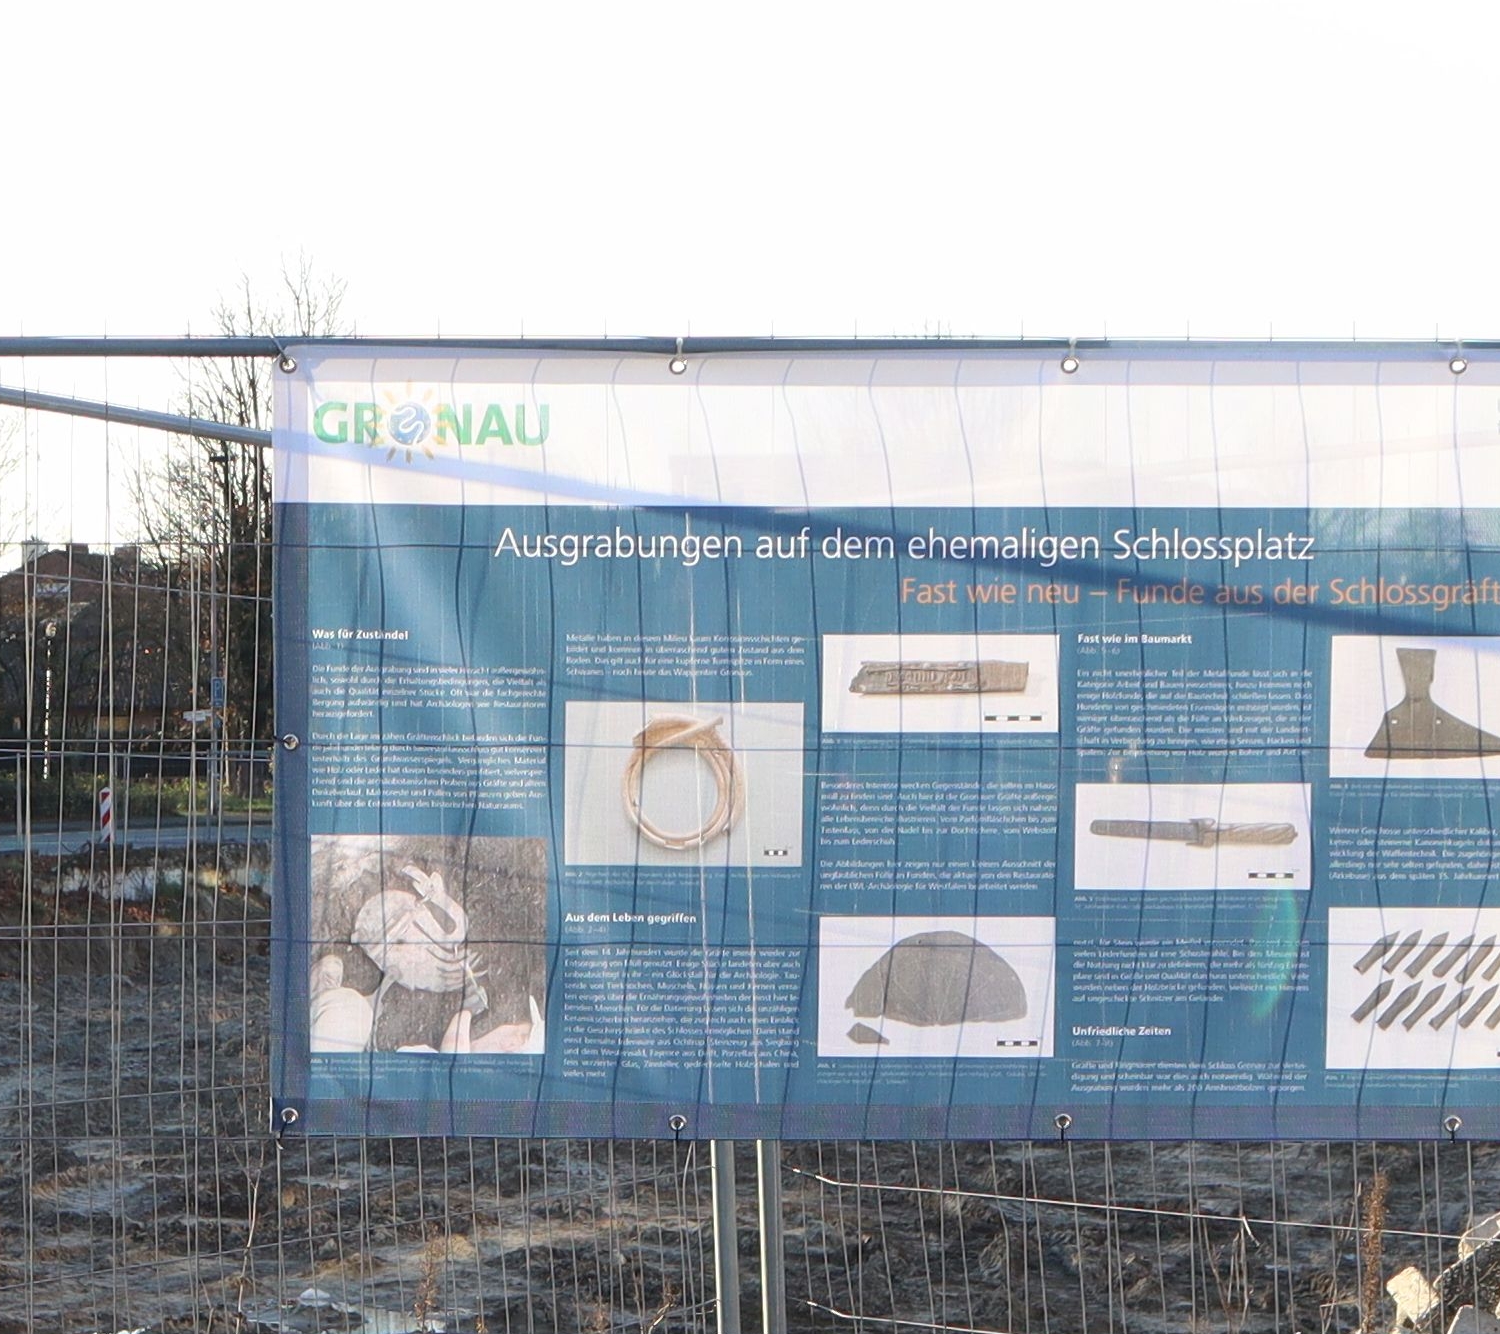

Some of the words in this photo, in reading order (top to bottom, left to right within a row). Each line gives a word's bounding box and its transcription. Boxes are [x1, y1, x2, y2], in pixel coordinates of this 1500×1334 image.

[494, 527, 742, 566] Ausgrabungen
[755, 527, 810, 558] auf
[821, 527, 895, 558] dem
[908, 528, 1099, 566] ehemaligen
[1114, 529, 1314, 567] Schlossplatz
[902, 578, 957, 603] Fast
[967, 578, 1015, 603] wie
[1028, 584, 1079, 603] neu
[1117, 578, 1205, 604] Funde
[1215, 583, 1262, 604] aus
[1274, 578, 1319, 604] der
[312, 631, 334, 639] Was
[338, 630, 353, 639] für
[1078, 635, 1099, 643] Fast
[1102, 635, 1122, 643] wie
[1125, 635, 1138, 643] im
[1141, 635, 1192, 644] Baumarkt
[565, 914, 584, 922] Aus
[588, 913, 610, 922] dem
[613, 913, 644, 923] Leben
[647, 913, 696, 925] gegriffen
[1073, 1026, 1136, 1036] Unfriedliche
[1138, 1027, 1171, 1036] Zeiten
